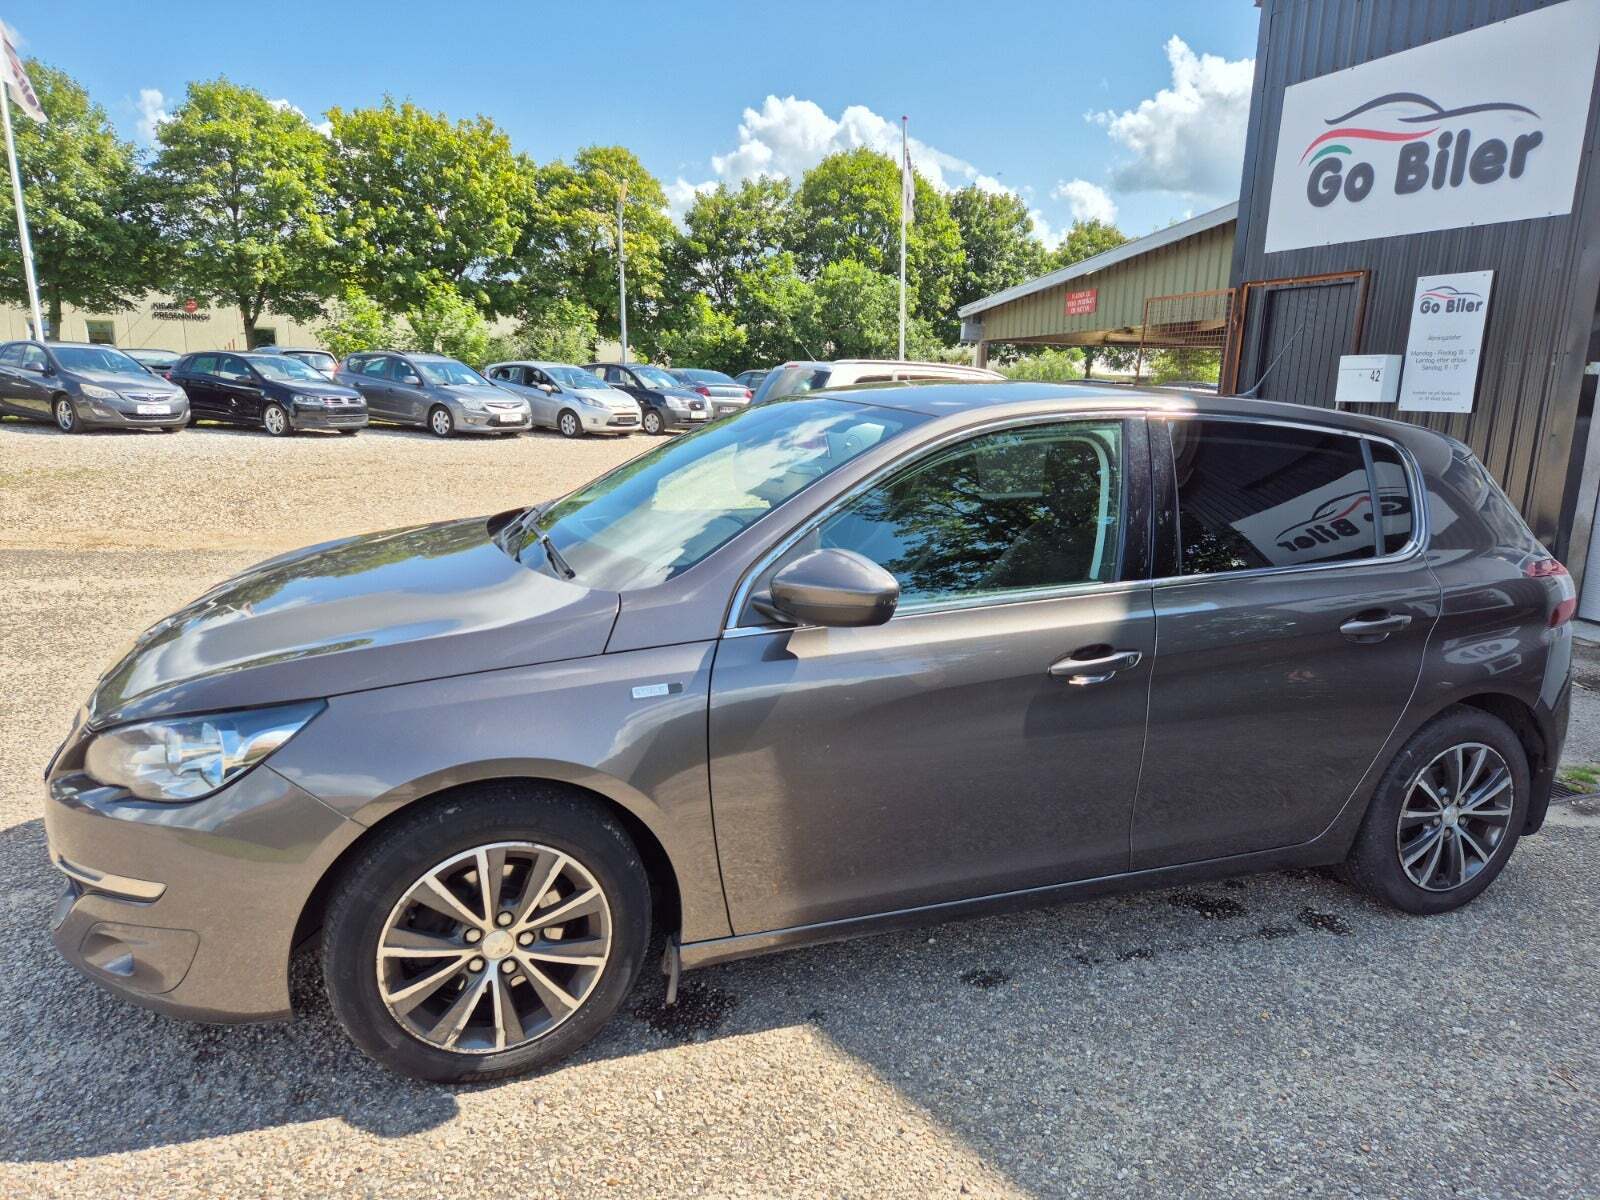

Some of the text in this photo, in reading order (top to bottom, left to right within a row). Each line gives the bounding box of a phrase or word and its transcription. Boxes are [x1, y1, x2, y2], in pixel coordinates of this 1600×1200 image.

[1307, 128, 1543, 208] Go Biler
[1420, 298, 1483, 314] Go Biler
[1370, 369, 1381, 382] 42
